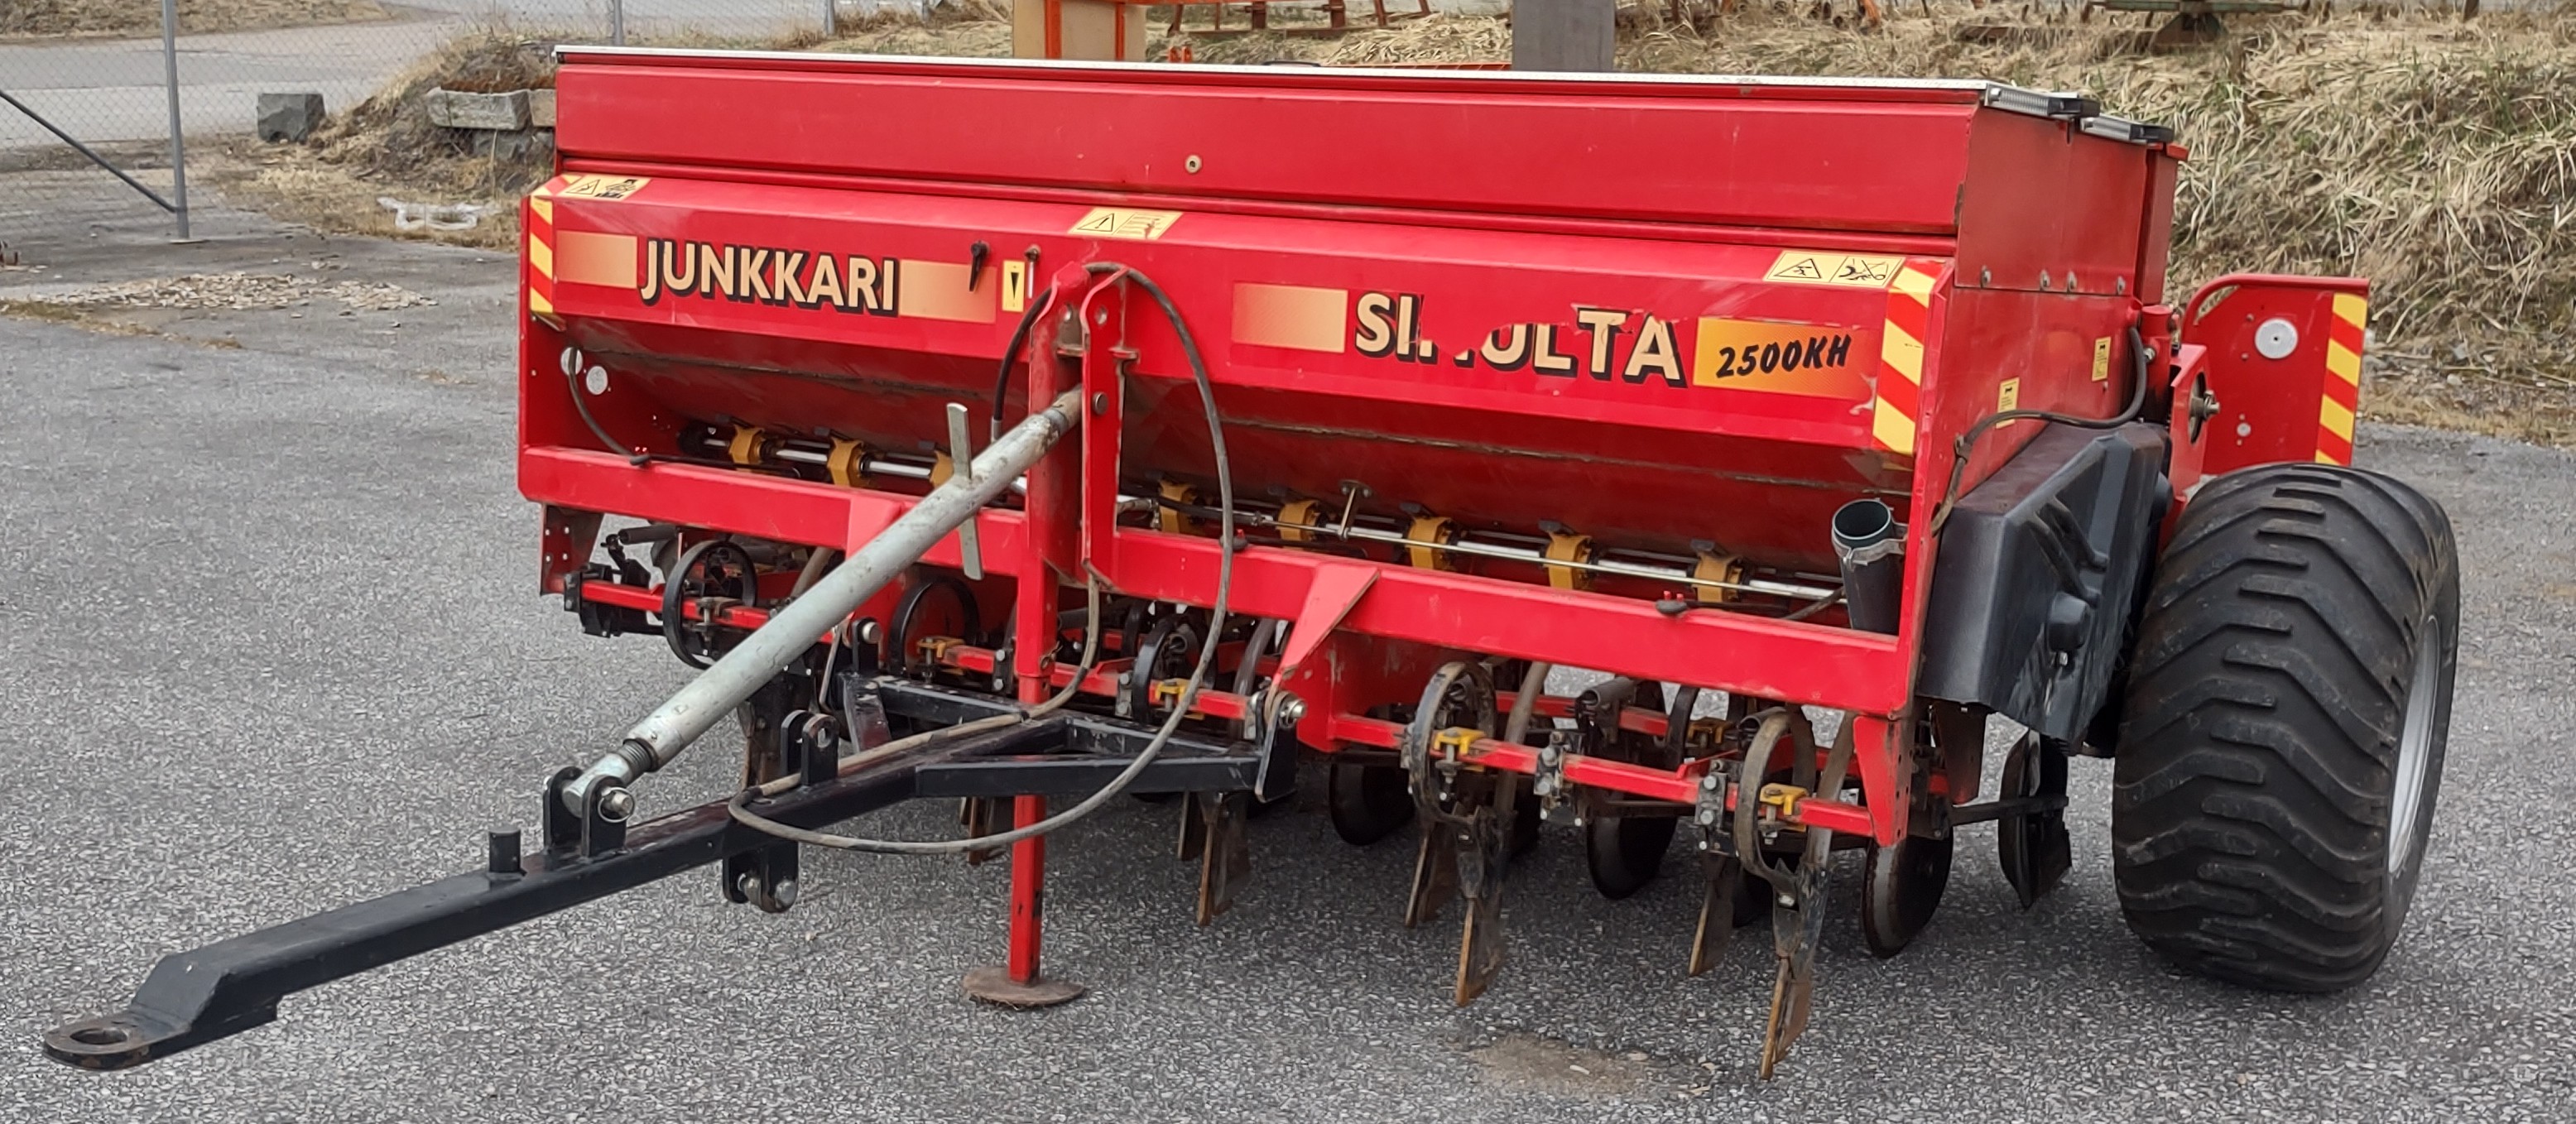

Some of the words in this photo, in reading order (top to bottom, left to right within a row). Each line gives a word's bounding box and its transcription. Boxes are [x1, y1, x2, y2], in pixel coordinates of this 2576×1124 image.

[639, 238, 899, 317] JUNKKARI
[1354, 291, 1688, 388] SIULTA
[1715, 334, 1853, 379] 2500KH
